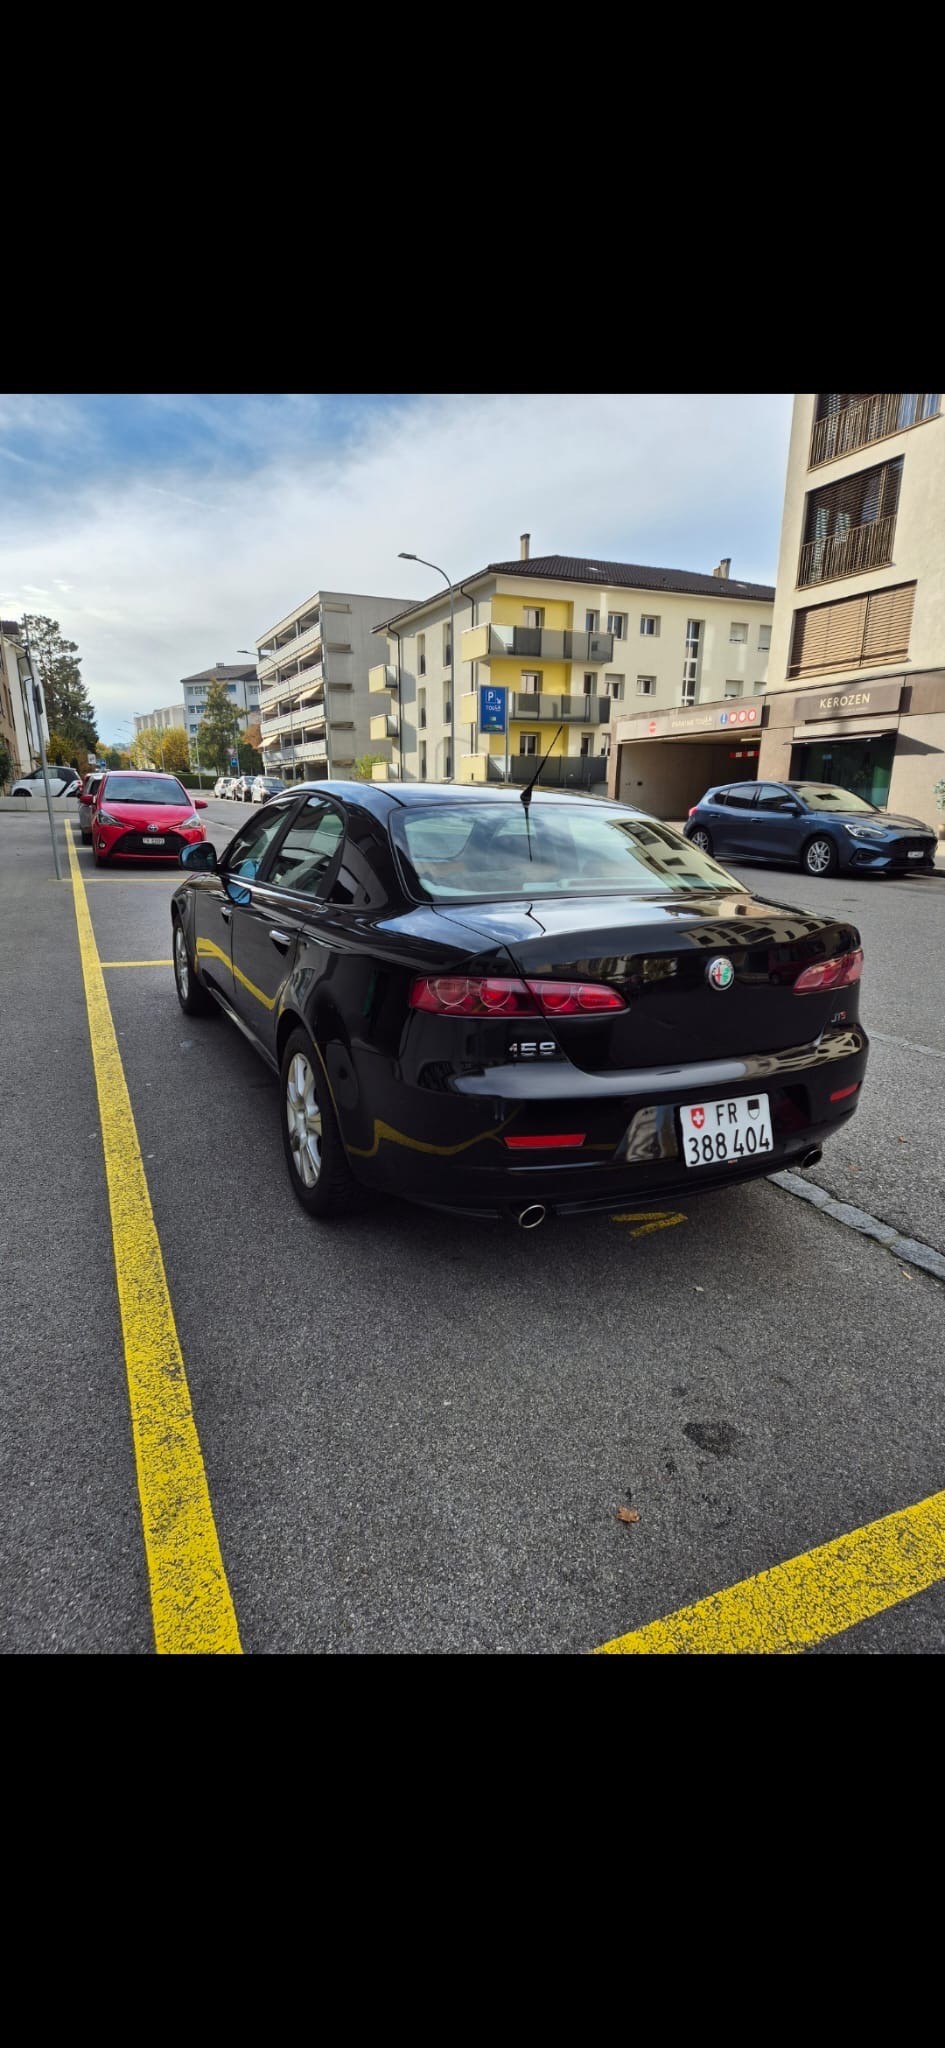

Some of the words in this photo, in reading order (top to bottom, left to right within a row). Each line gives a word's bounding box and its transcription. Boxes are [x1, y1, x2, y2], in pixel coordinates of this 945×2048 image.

[487, 691, 494, 702] P
[820, 693, 870, 708] KEROZEN
[509, 1042, 556, 1057] 159
[716, 1102, 738, 1126] FR
